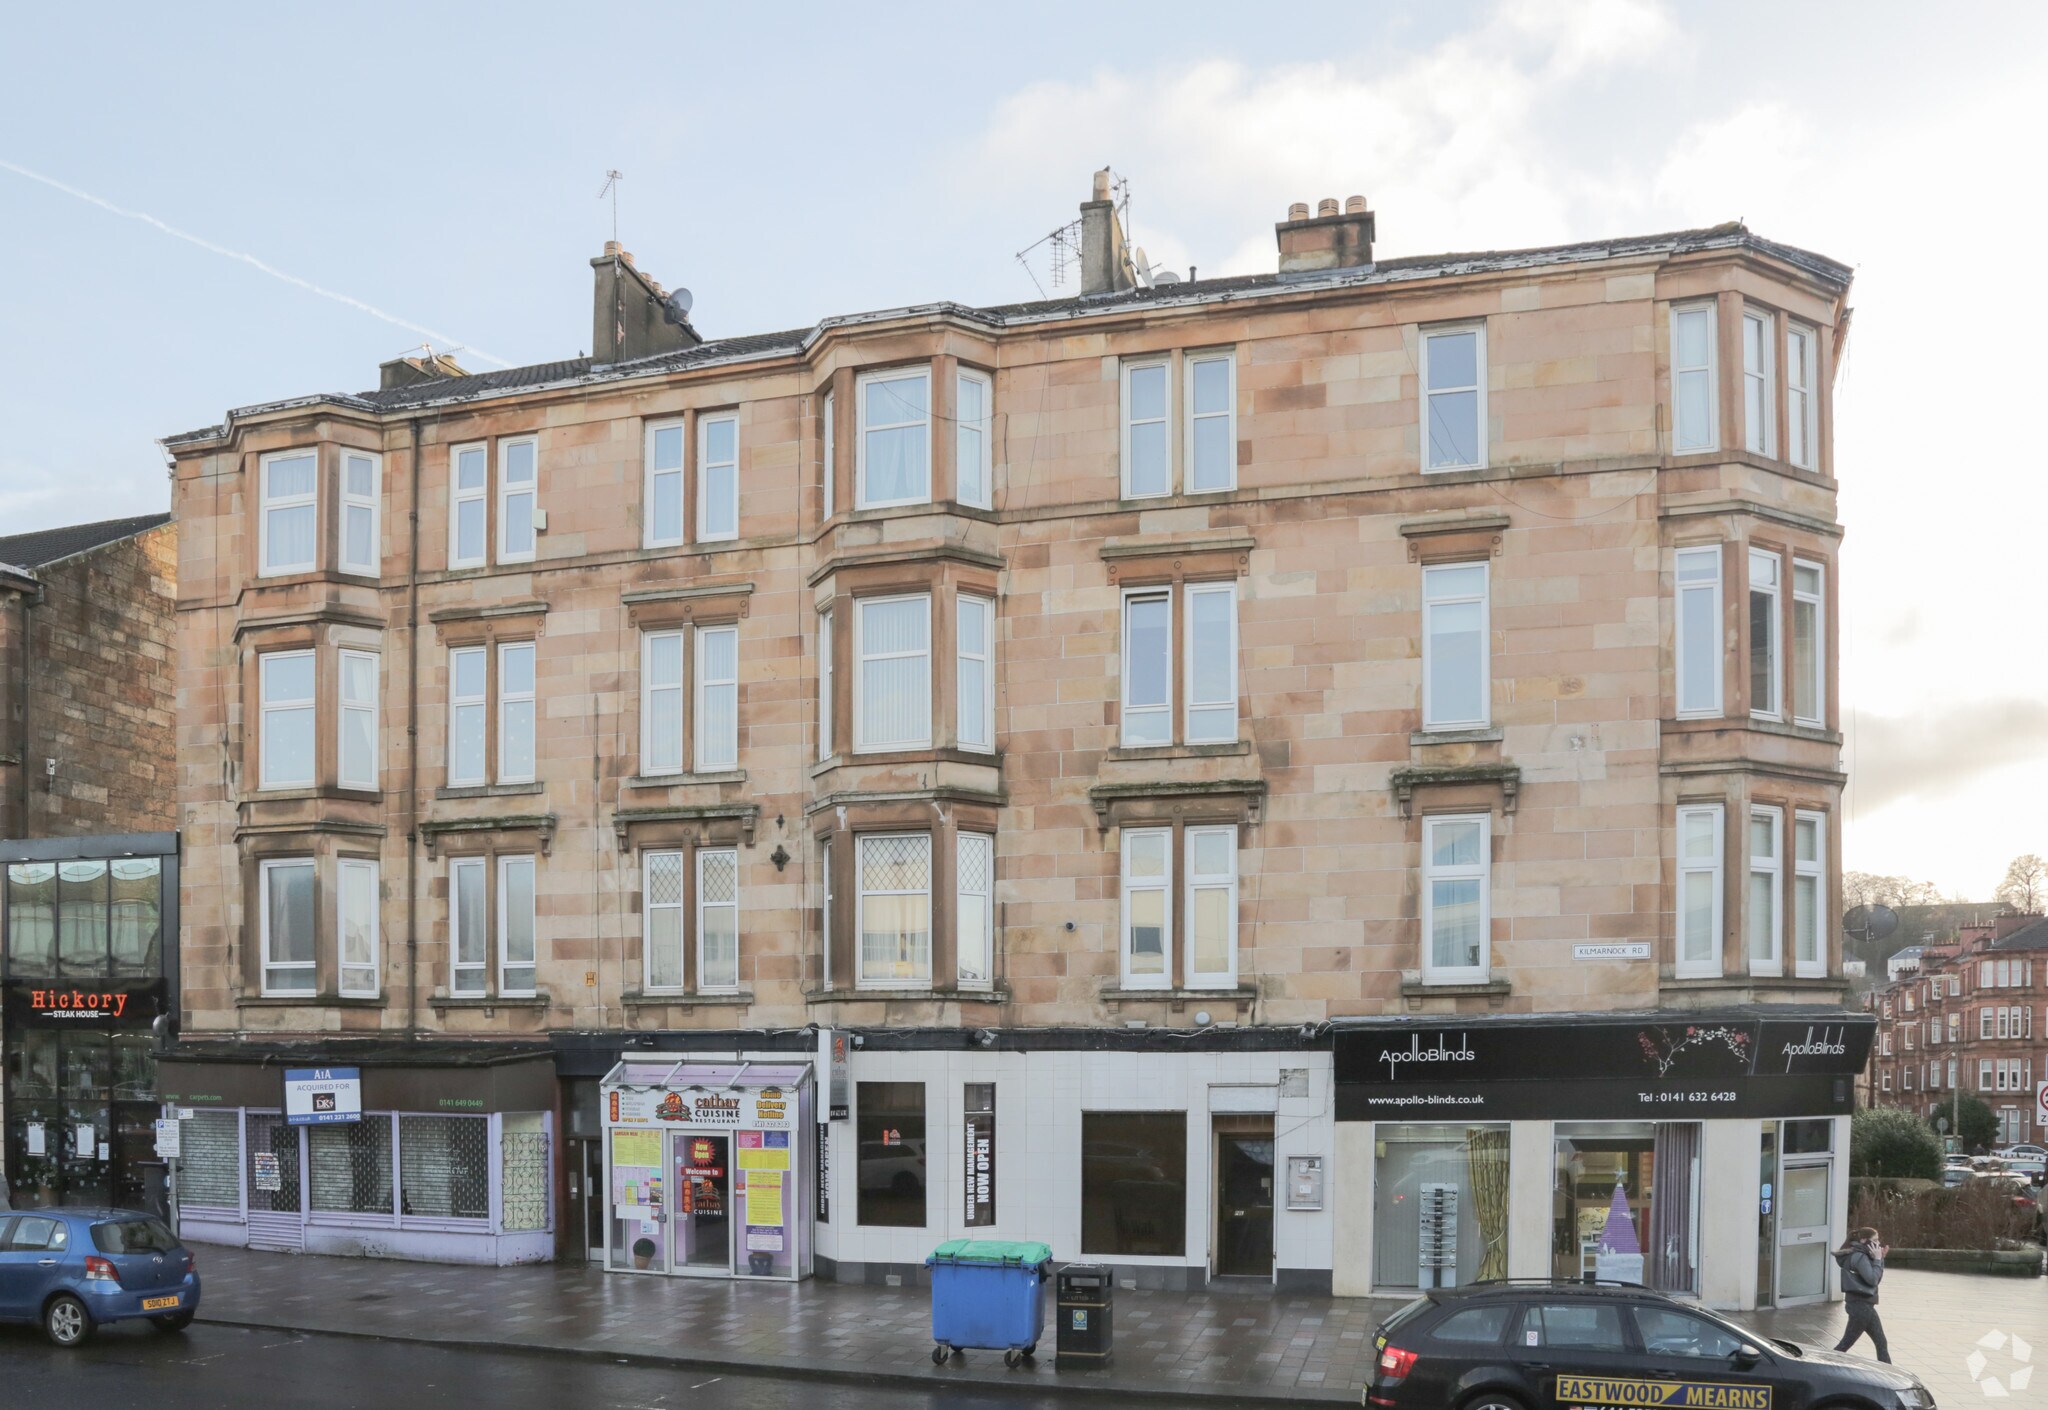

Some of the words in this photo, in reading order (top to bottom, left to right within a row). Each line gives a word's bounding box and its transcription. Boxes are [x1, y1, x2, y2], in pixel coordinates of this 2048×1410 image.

[31, 989, 127, 1017] Hickory
[53, 1010, 75, 1018] STEAK
[76, 1010, 99, 1018] HOUSE
[1379, 1032, 1475, 1080] ApolloBlinds
[1781, 1026, 1845, 1074] ApolloBlinds
[695, 1093, 740, 1109] cathay
[1368, 1095, 1484, 1106] www.apollo-blinds.co.uk
[1688, 1092, 1708, 1101] 632
[1710, 1092, 1736, 1101] 6428
[756, 1100, 786, 1110] Delivery
[695, 1109, 740, 1118] CUISINE
[758, 1110, 784, 1119] Hotline
[694, 1150, 709, 1158] Open
[977, 1139, 989, 1170] OPEN
[977, 1172, 989, 1202] NOW
[1559, 1380, 1663, 1403] EASTWOOD
[1685, 1387, 1767, 1408] MEARNS
